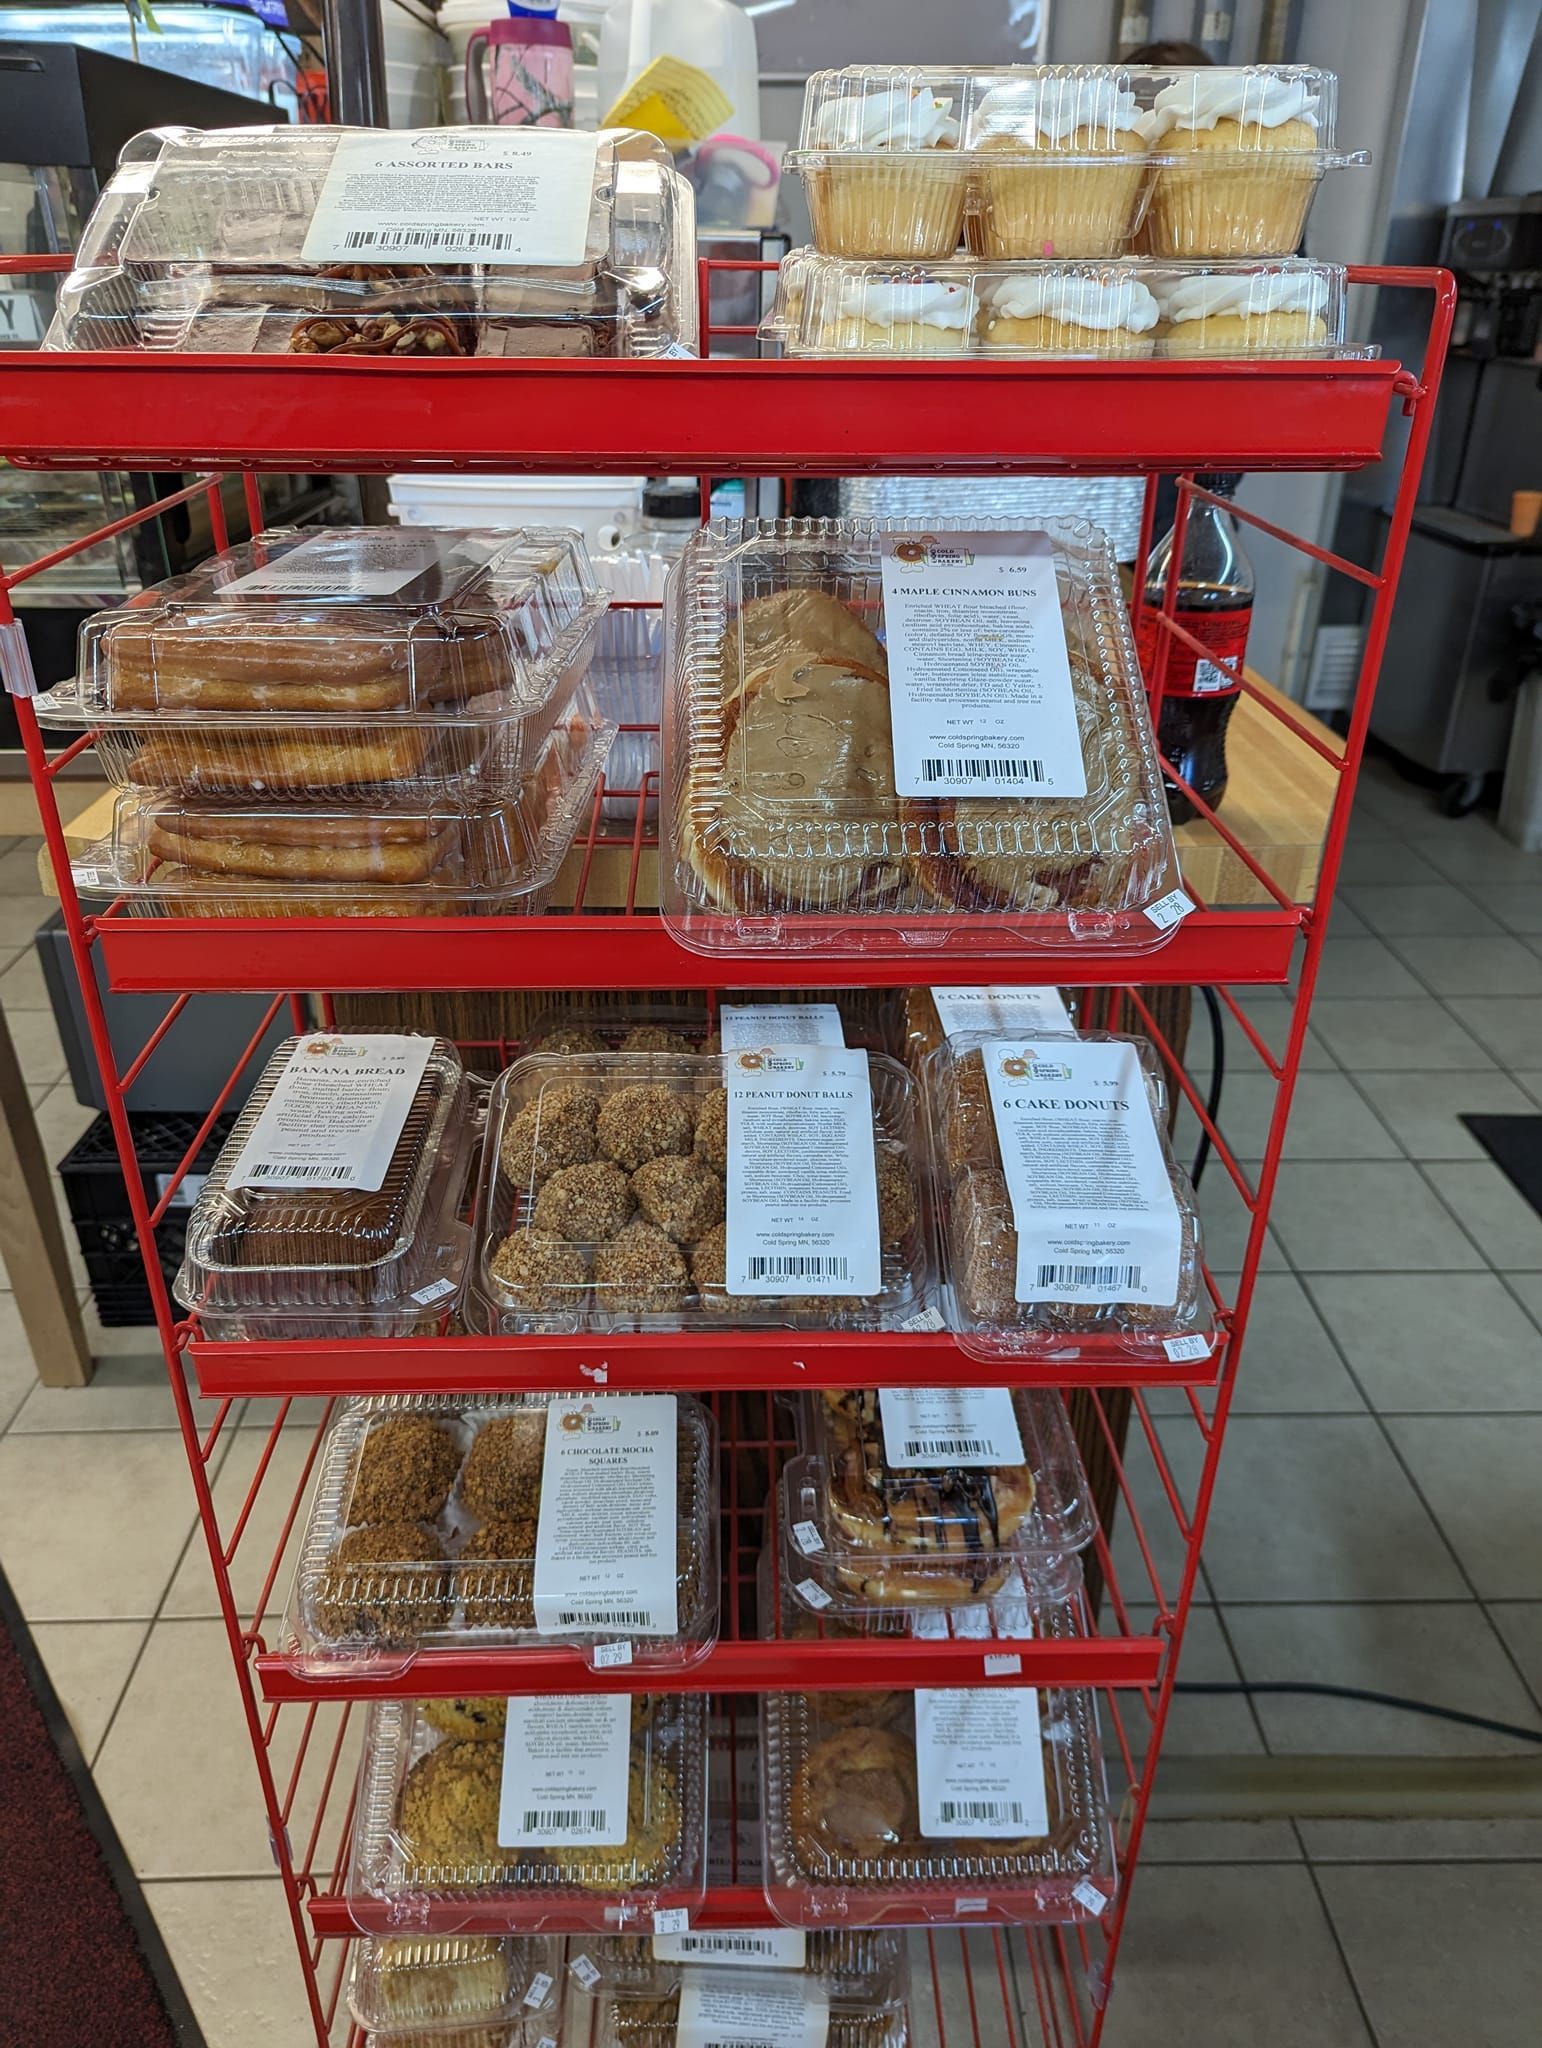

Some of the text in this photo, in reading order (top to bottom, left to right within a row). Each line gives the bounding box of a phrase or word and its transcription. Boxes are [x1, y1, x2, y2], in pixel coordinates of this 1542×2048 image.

[388, 161, 468, 169] ASSORTED
[473, 162, 513, 170] BARS
[900, 588, 940, 596] MAPLE
[942, 588, 1005, 597] CINNAMON
[1008, 590, 1038, 598] BUNS
[1048, 778, 1054, 786] 5
[1150, 893, 1178, 913] SELL BY
[1157, 902, 1185, 923] 2 28
[289, 1067, 406, 1076] BANANA BREAD
[786, 1091, 820, 1099] DONUT
[822, 1091, 854, 1099] BALLS
[1002, 1099, 1130, 1111] 6 CAKE DONUTS
[1070, 1248, 1090, 1256] Spring
[1054, 1284, 1080, 1292] 30907
[908, 1314, 924, 1327] SELL
[1170, 1338, 1188, 1348] SELL
[567, 1448, 620, 1456] CHOCOLATE
[588, 1457, 628, 1465] SQUARES
